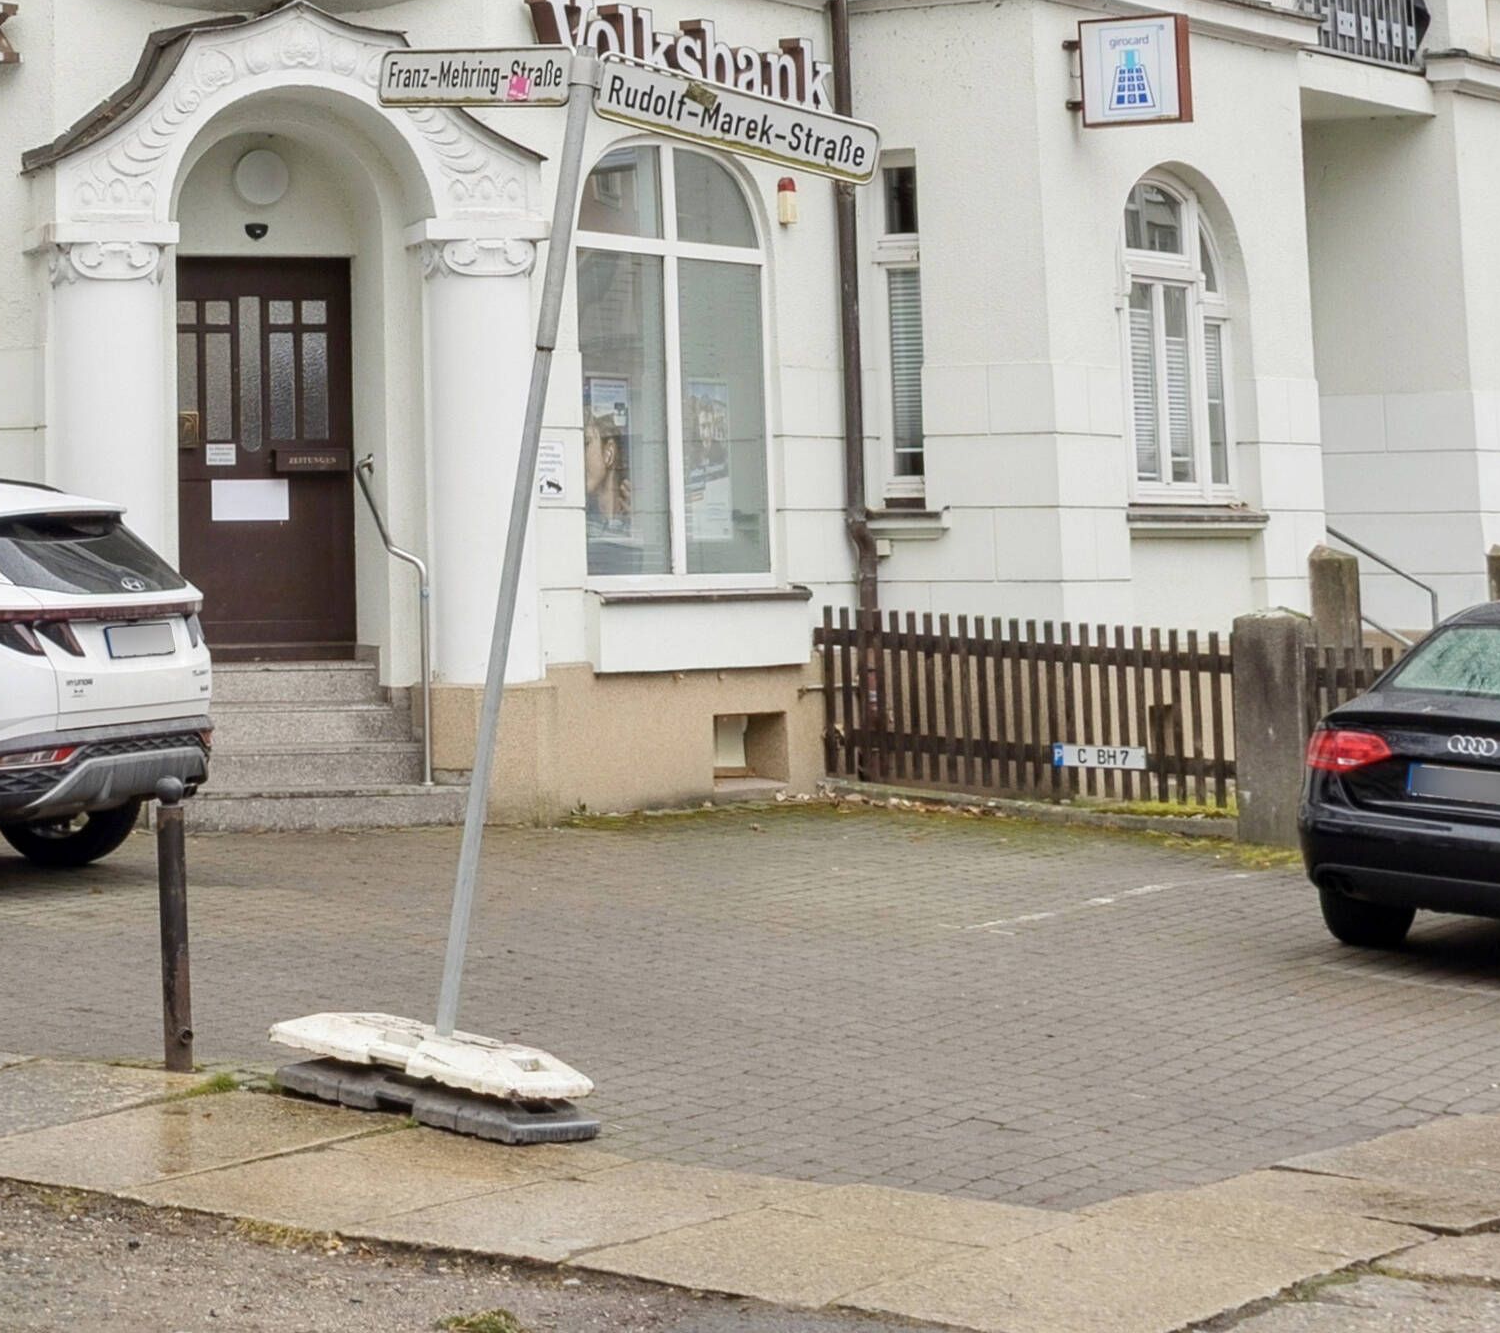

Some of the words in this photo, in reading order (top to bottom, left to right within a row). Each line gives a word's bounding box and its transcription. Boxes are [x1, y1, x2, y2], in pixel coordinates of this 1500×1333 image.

[1109, 34, 1149, 49] girocard
[387, 59, 563, 95] Franz-Mehring-Straße
[607, 75, 865, 167] Rudolf-Marek-Straße
[1077, 748, 1087, 764] C
[1097, 749, 1117, 765] BH
[1120, 750, 1129, 766] 7
